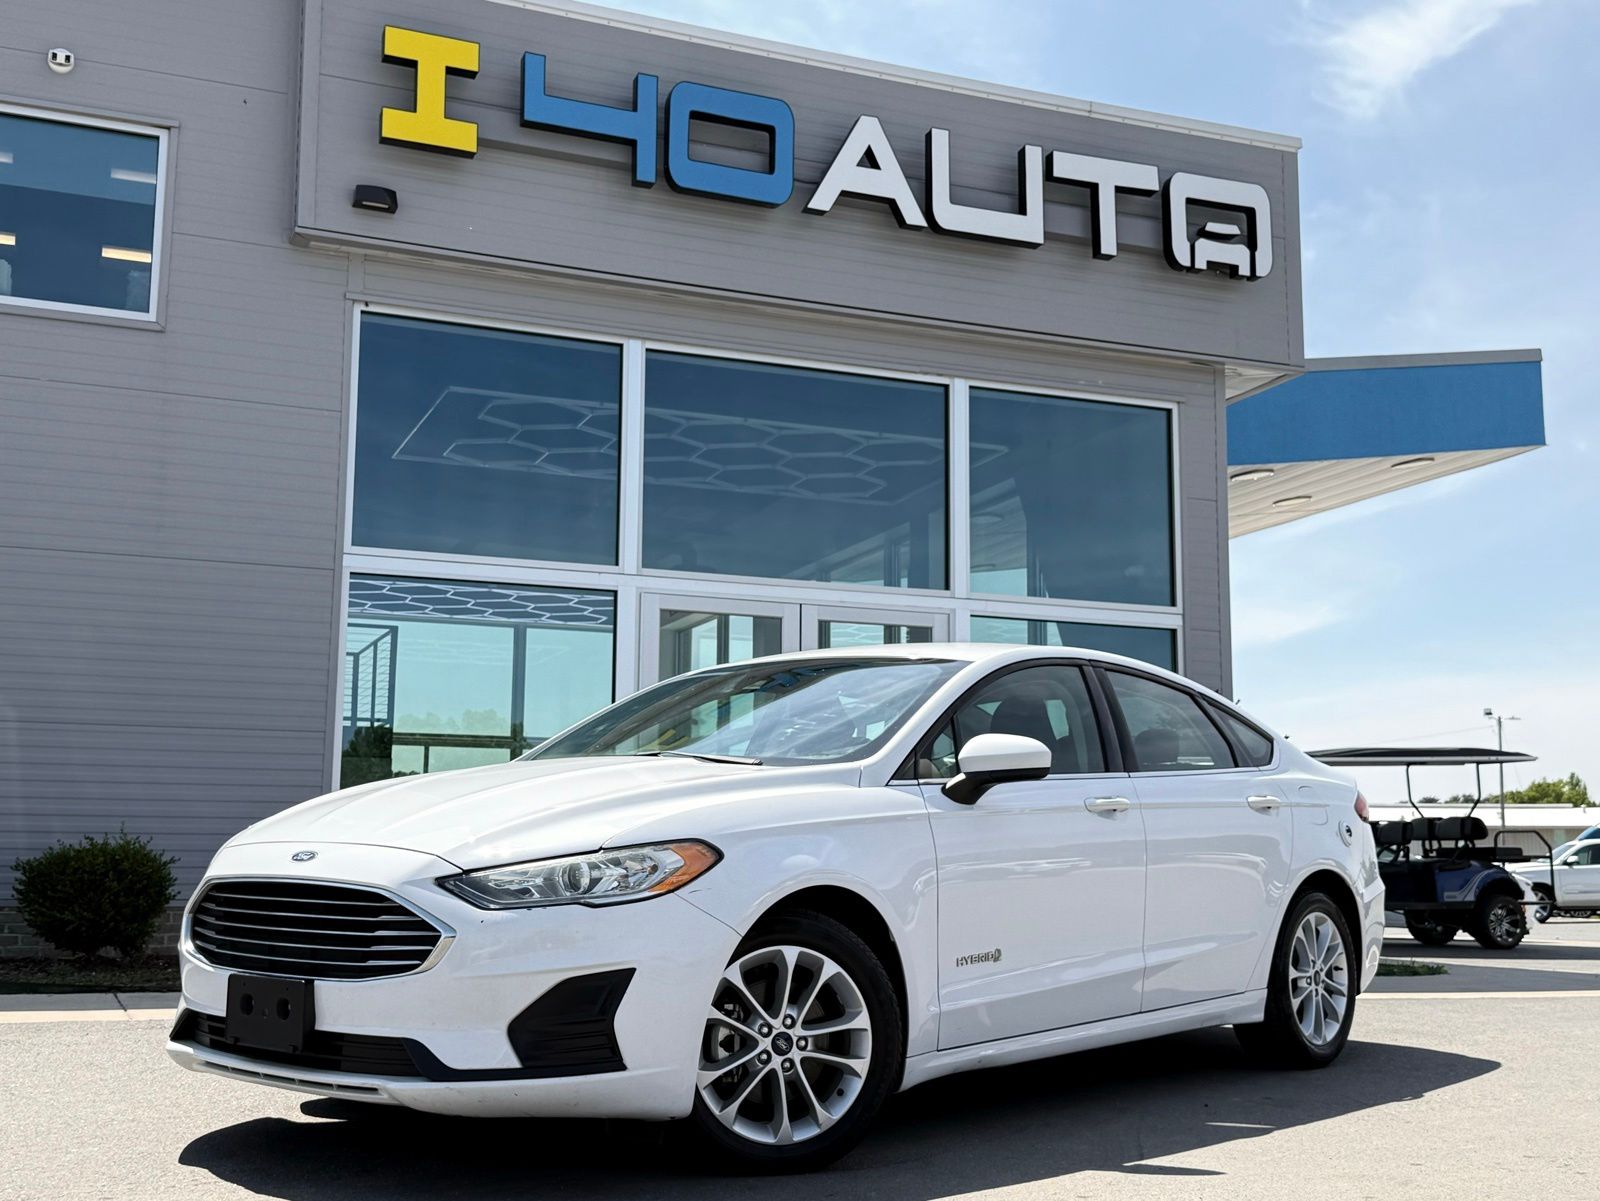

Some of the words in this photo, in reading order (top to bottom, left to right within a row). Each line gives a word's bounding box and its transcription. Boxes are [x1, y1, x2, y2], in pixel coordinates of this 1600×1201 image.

[379, 25, 480, 158] I
[520, 51, 795, 208] 40
[802, 114, 1273, 281] AUTO
[956, 950, 994, 967] HYBRID
